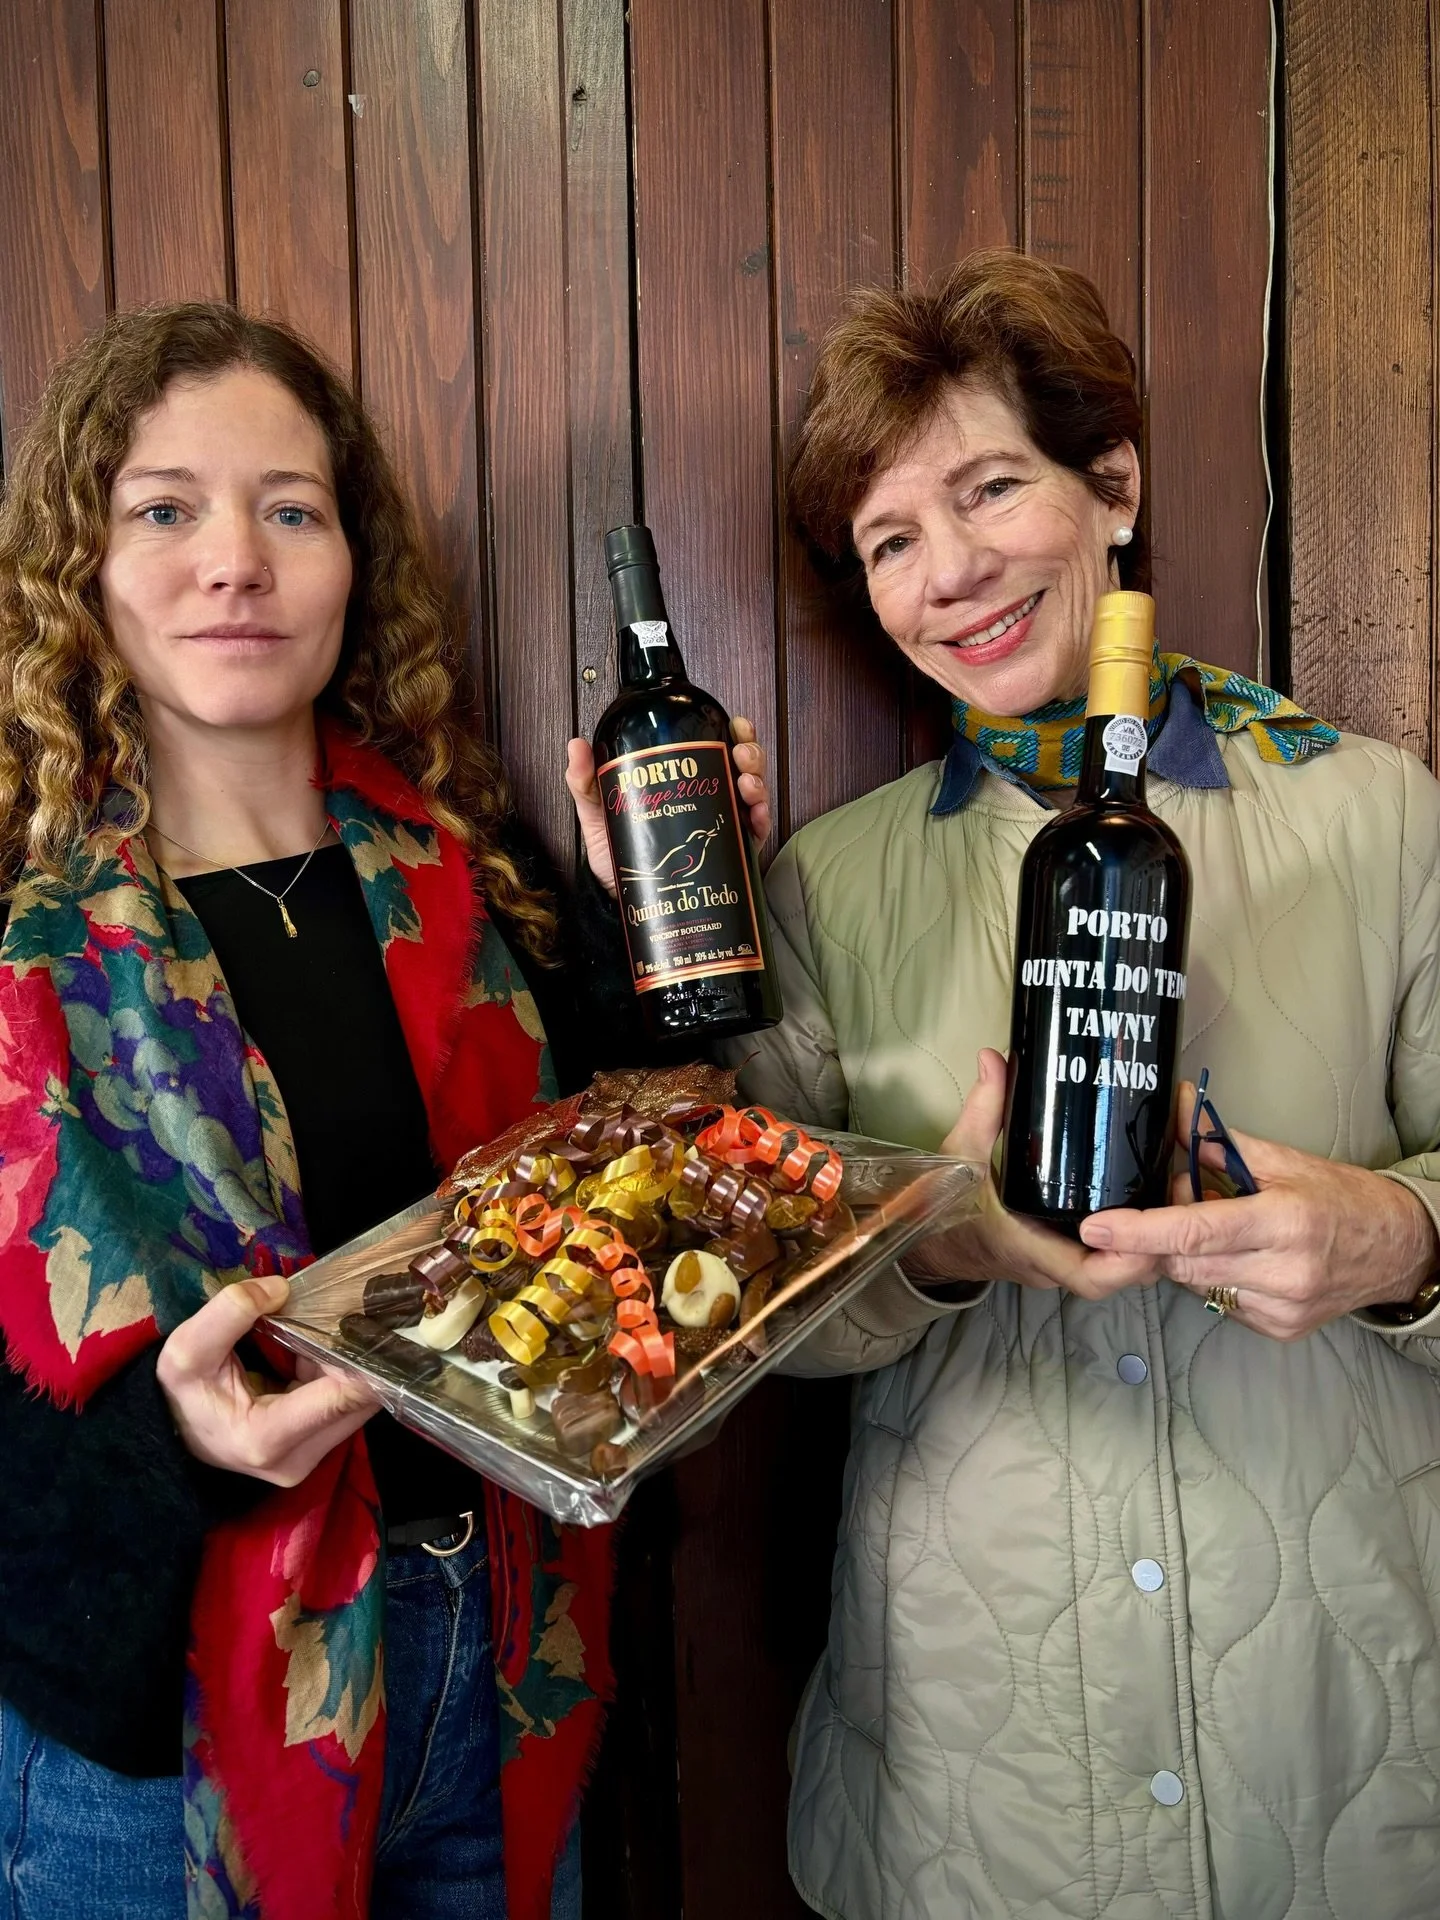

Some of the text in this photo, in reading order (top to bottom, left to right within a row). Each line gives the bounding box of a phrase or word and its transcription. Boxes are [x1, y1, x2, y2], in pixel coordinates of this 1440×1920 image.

[617, 757, 698, 793] PORTO
[674, 777, 720, 799] 2003
[627, 900, 675, 927] Quinta
[677, 888, 699, 912] do
[697, 883, 739, 908] Tedo
[649, 929, 680, 943] VINCENT
[680, 922, 722, 936] BOUCHARD
[1066, 907, 1168, 943] PORTO
[1021, 958, 1106, 989] QUINTA
[1112, 963, 1149, 994] DO
[1066, 1007, 1156, 1042] TAWNY
[1056, 1054, 1158, 1091] 10 ANOS
